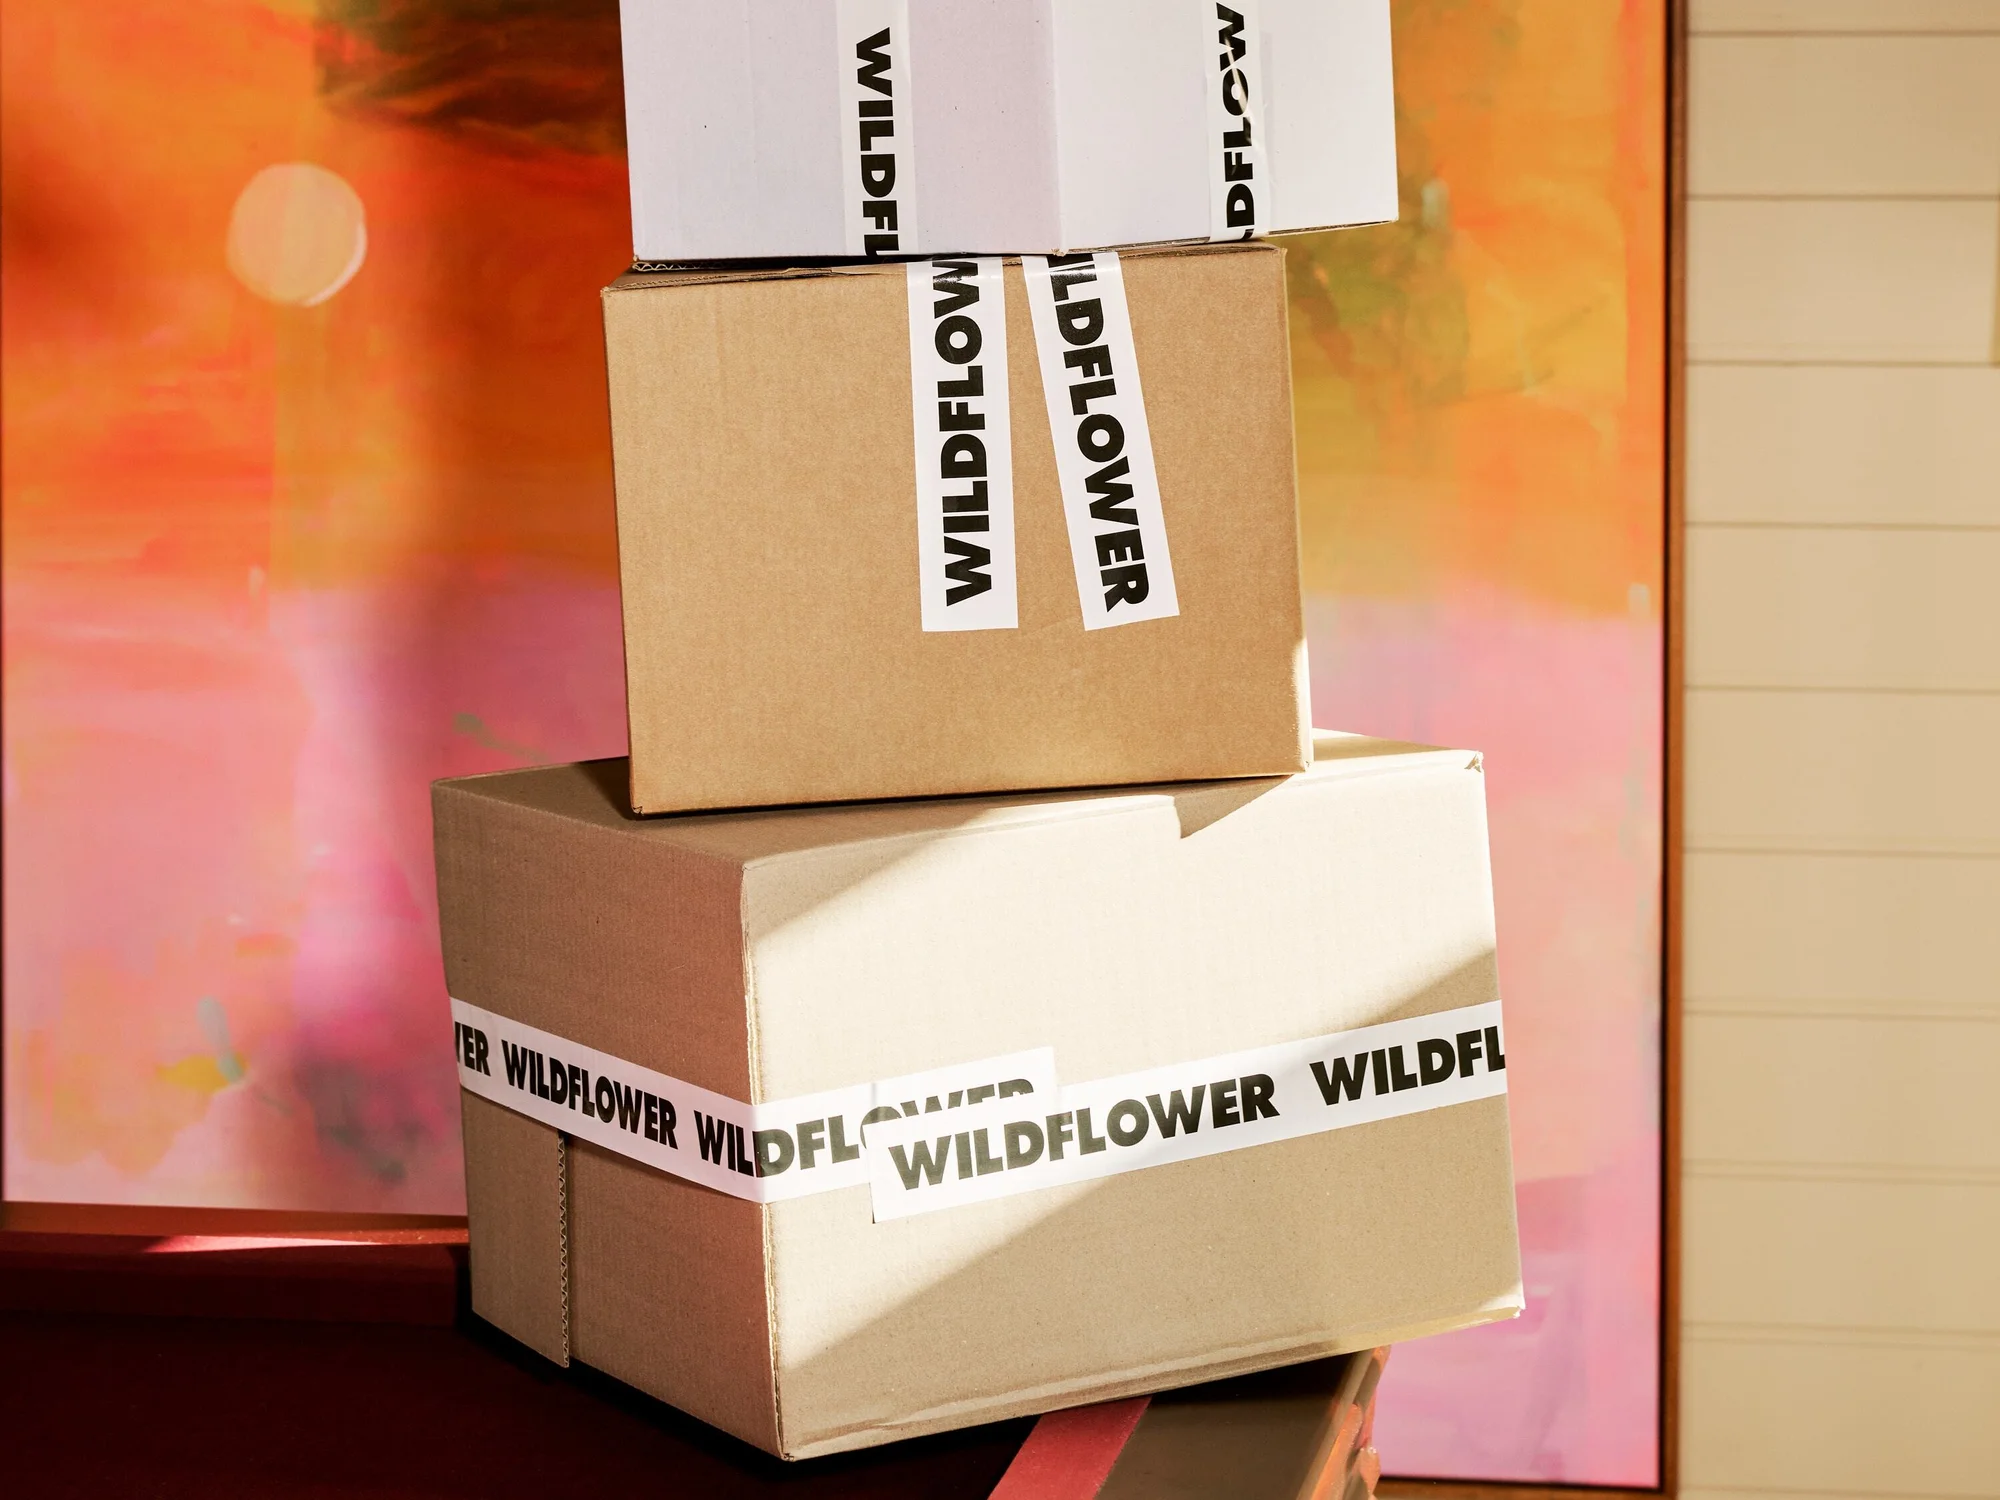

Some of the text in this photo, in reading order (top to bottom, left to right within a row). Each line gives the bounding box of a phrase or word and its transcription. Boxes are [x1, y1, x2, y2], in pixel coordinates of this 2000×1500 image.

[856, 26, 899, 256] WILDFL
[932, 256, 992, 607] WILDFLOW
[501, 1039, 678, 1149] WILDFLOWER
[888, 1025, 1507, 1191] WILDFLOWER WILDFL
